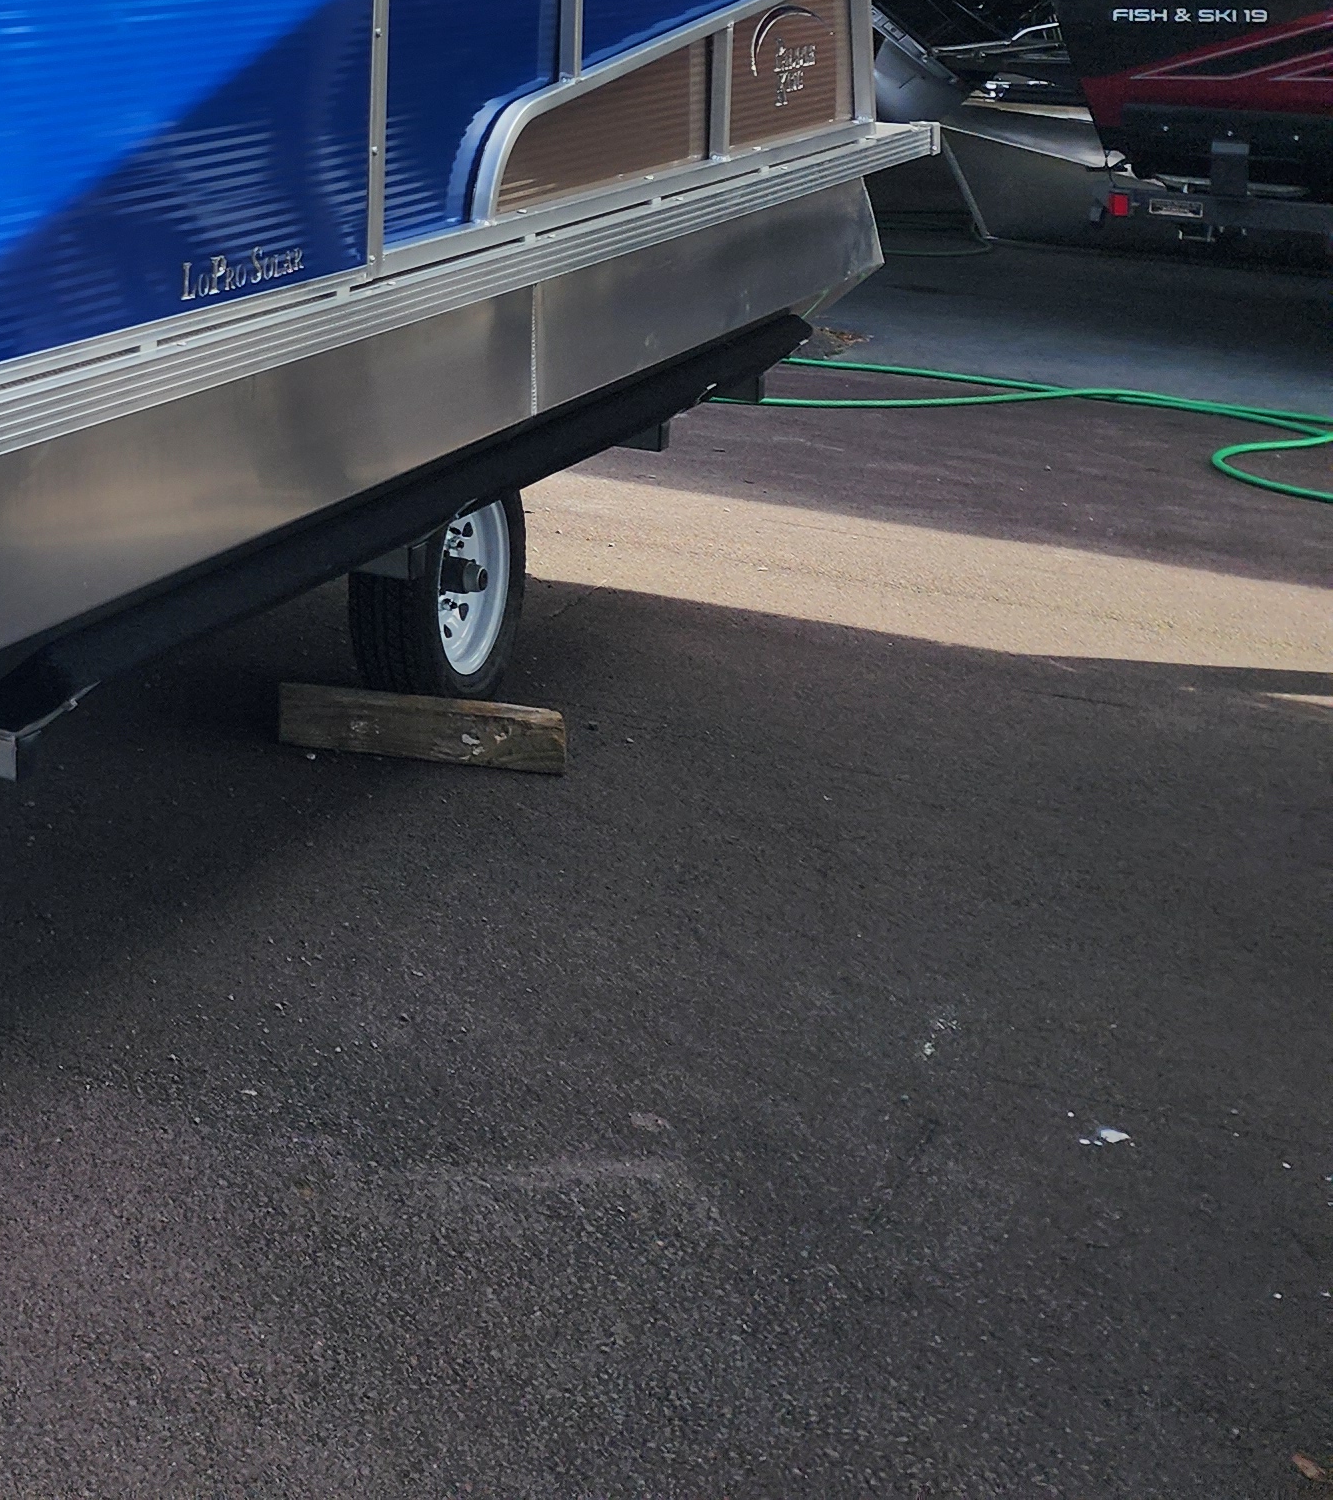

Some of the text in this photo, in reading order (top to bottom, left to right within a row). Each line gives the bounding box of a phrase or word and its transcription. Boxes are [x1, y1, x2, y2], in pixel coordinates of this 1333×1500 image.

[1112, 7, 1268, 23] FISH & SKI 19
